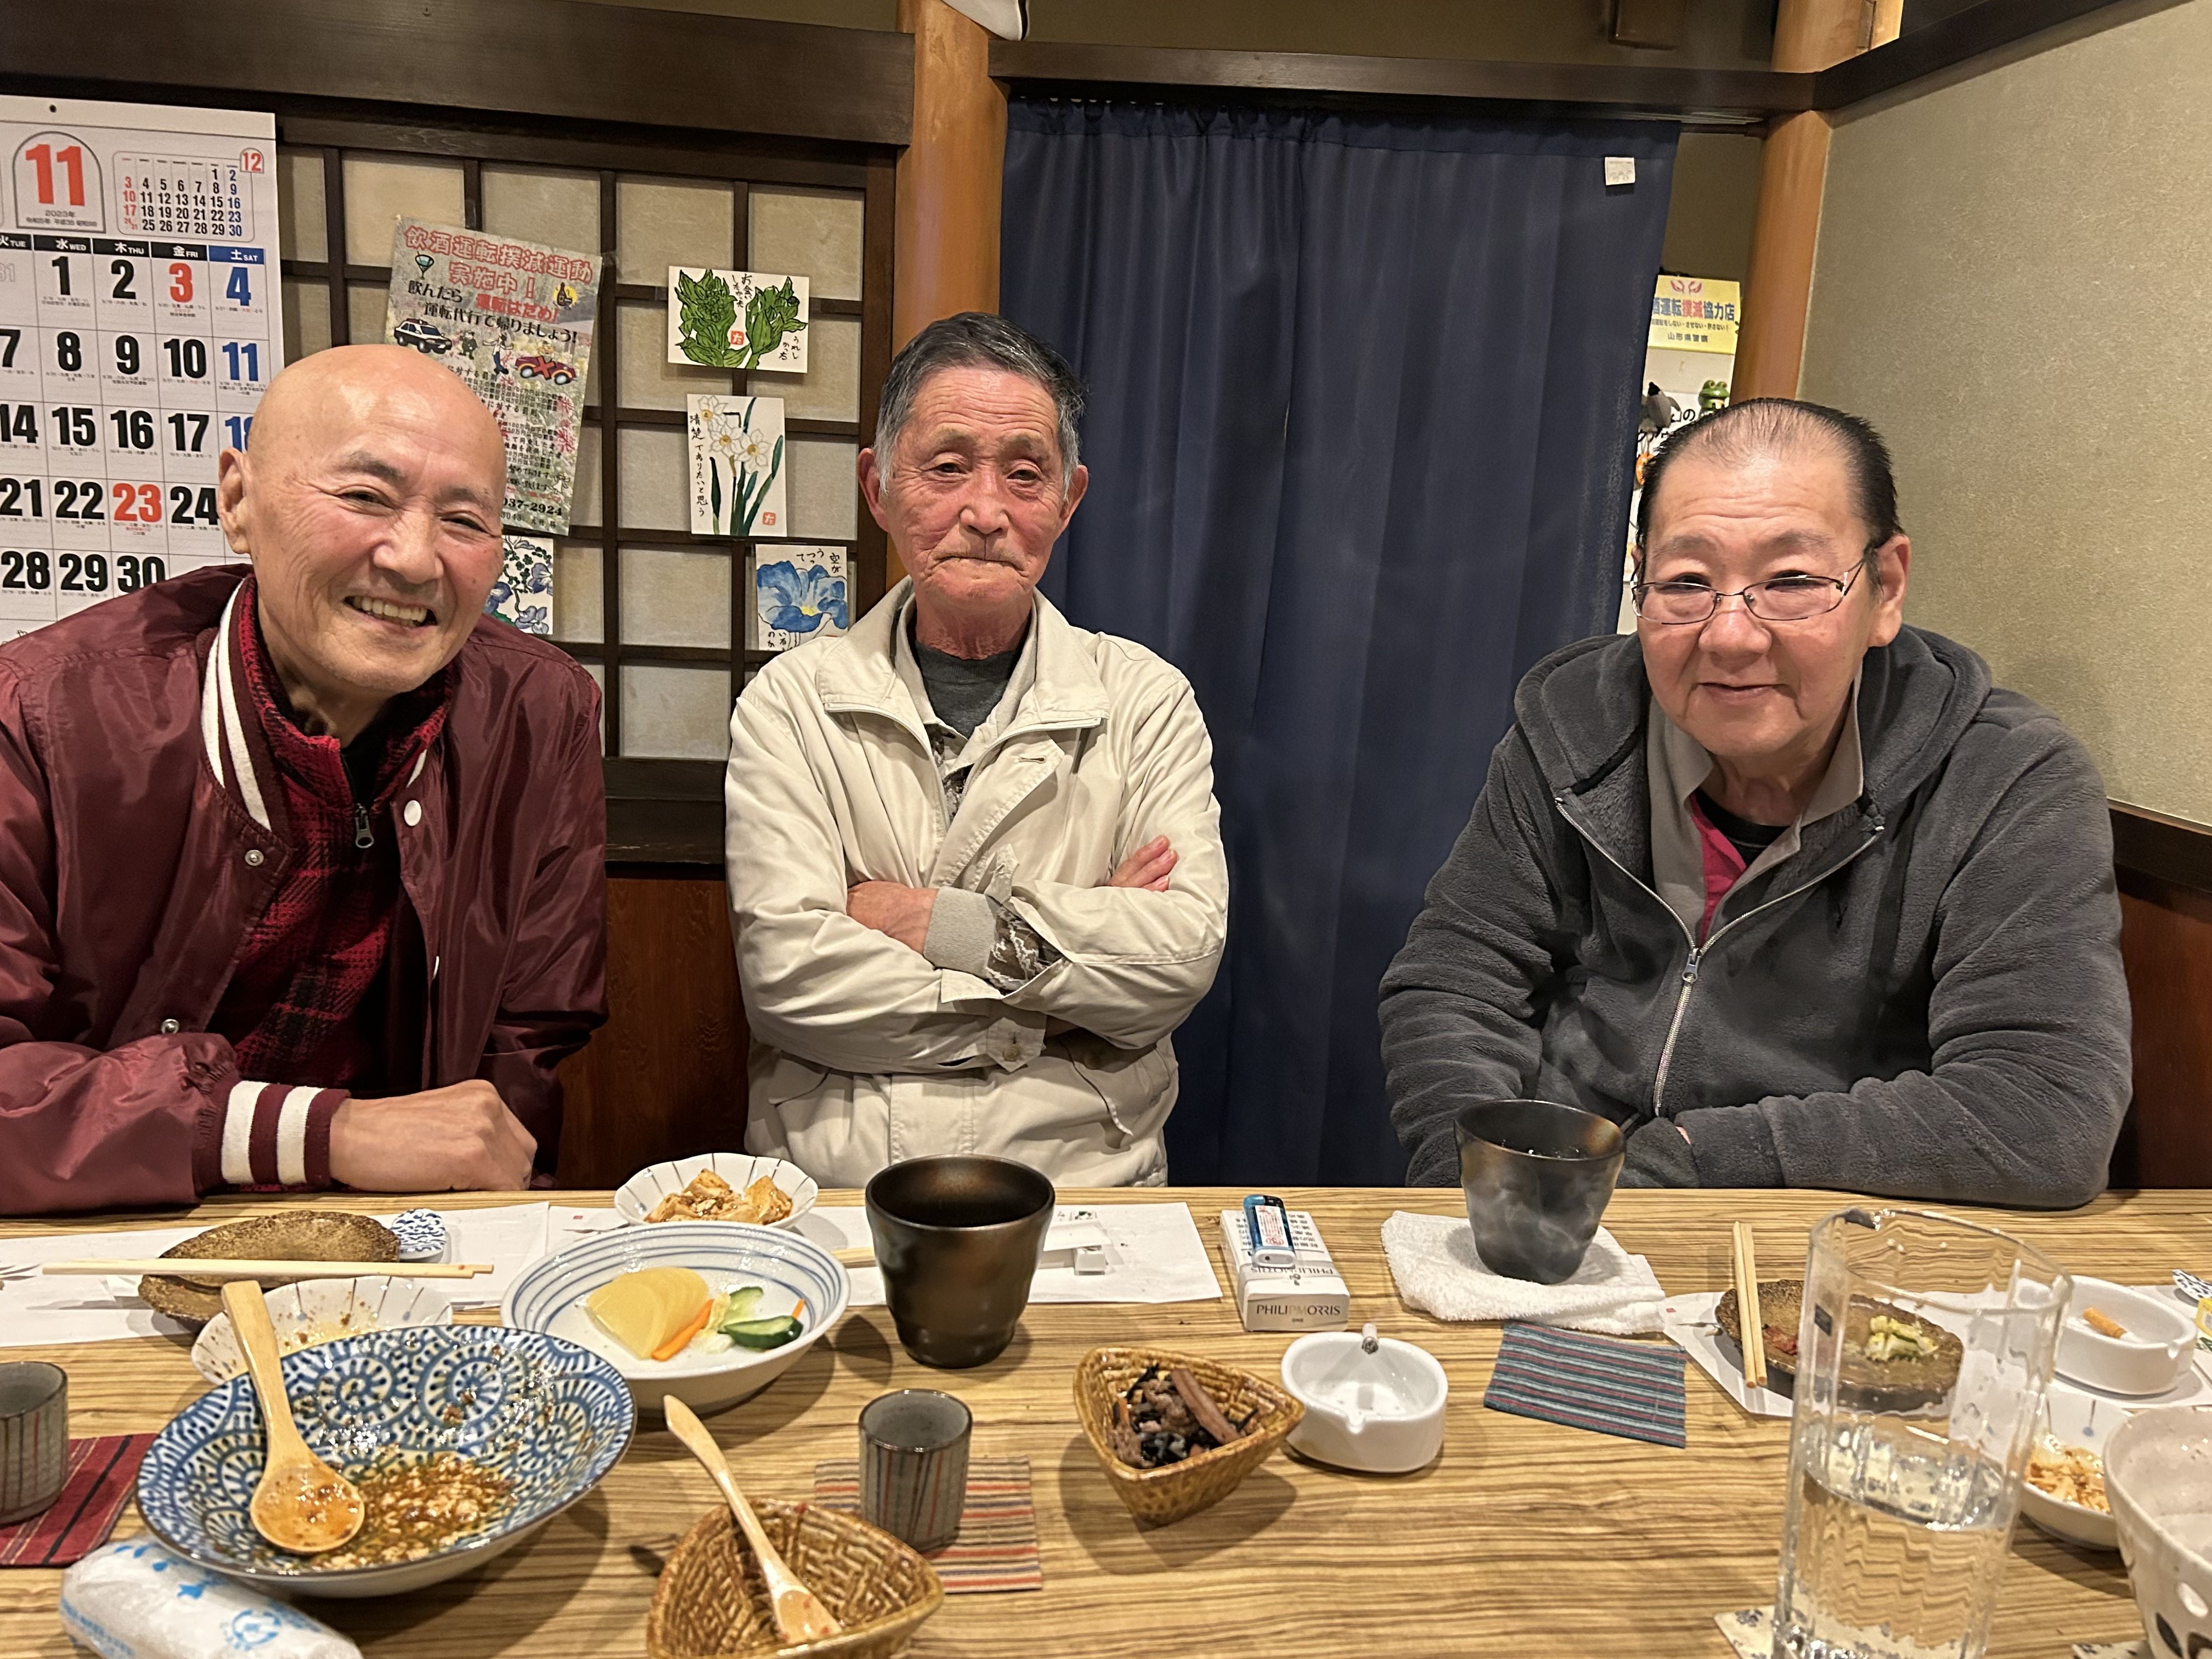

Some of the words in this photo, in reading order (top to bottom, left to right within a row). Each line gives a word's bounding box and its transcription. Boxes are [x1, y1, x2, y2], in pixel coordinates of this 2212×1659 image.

[242, 152, 262, 171] 12
[25, 144, 85, 206] 11
[212, 168, 217, 180] 1
[229, 170, 236, 181] 2
[125, 177, 132, 188] 3
[143, 178, 149, 189] 4
[160, 179, 166, 190] 5
[178, 180, 184, 191] 6
[195, 182, 201, 193] 7
[213, 182, 219, 194] 8
[230, 184, 237, 195] 9
[123, 191, 136, 202] 10
[140, 192, 152, 203] 11
[158, 193, 171, 204] 12
[176, 194, 188, 206] 13
[193, 195, 206, 207] 14
[211, 196, 223, 208] 15
[228, 198, 240, 209] 16
[124, 204, 137, 216] 17
[141, 206, 154, 217] 18
[159, 206, 171, 218] 19
[176, 207, 189, 219] 20
[194, 208, 205, 220] 21
[211, 210, 224, 222] 22
[228, 211, 241, 223] 23
[143, 219, 155, 231] 25
[160, 221, 172, 232] 26
[177, 221, 190, 233] 27
[194, 223, 207, 234] 28
[212, 223, 224, 235] 29
[229, 224, 242, 236] 30
[55, 239, 69, 250] 水
[115, 242, 127, 253] 木
[127, 246, 144, 255] THU
[172, 246, 185, 257] 金
[230, 249, 242, 260] 土
[404, 225, 593, 284] 飲酒運転撲滅運動
[52, 256, 70, 296] 1
[111, 259, 136, 300] 2
[169, 262, 193, 303] 3
[227, 267, 251, 306] 4
[408, 280, 463, 303] 飲んだら
[1668, 332, 1708, 343] 山形県警察
[0, 330, 21, 368] 7
[57, 331, 82, 371] 8
[115, 335, 140, 375] 9
[164, 338, 206, 379] 10
[222, 342, 258, 382] 11
[0, 404, 38, 443] 14
[52, 407, 96, 446] 15
[110, 410, 154, 449] 16
[168, 413, 210, 452] 17
[0, 477, 42, 517] 21
[54, 480, 105, 520] 22
[112, 483, 162, 522] 23
[170, 486, 219, 525] 24
[1, 551, 50, 589] 28
[59, 554, 108, 592] 29
[117, 555, 165, 592] 30
[830, 552, 841, 573] 空が
